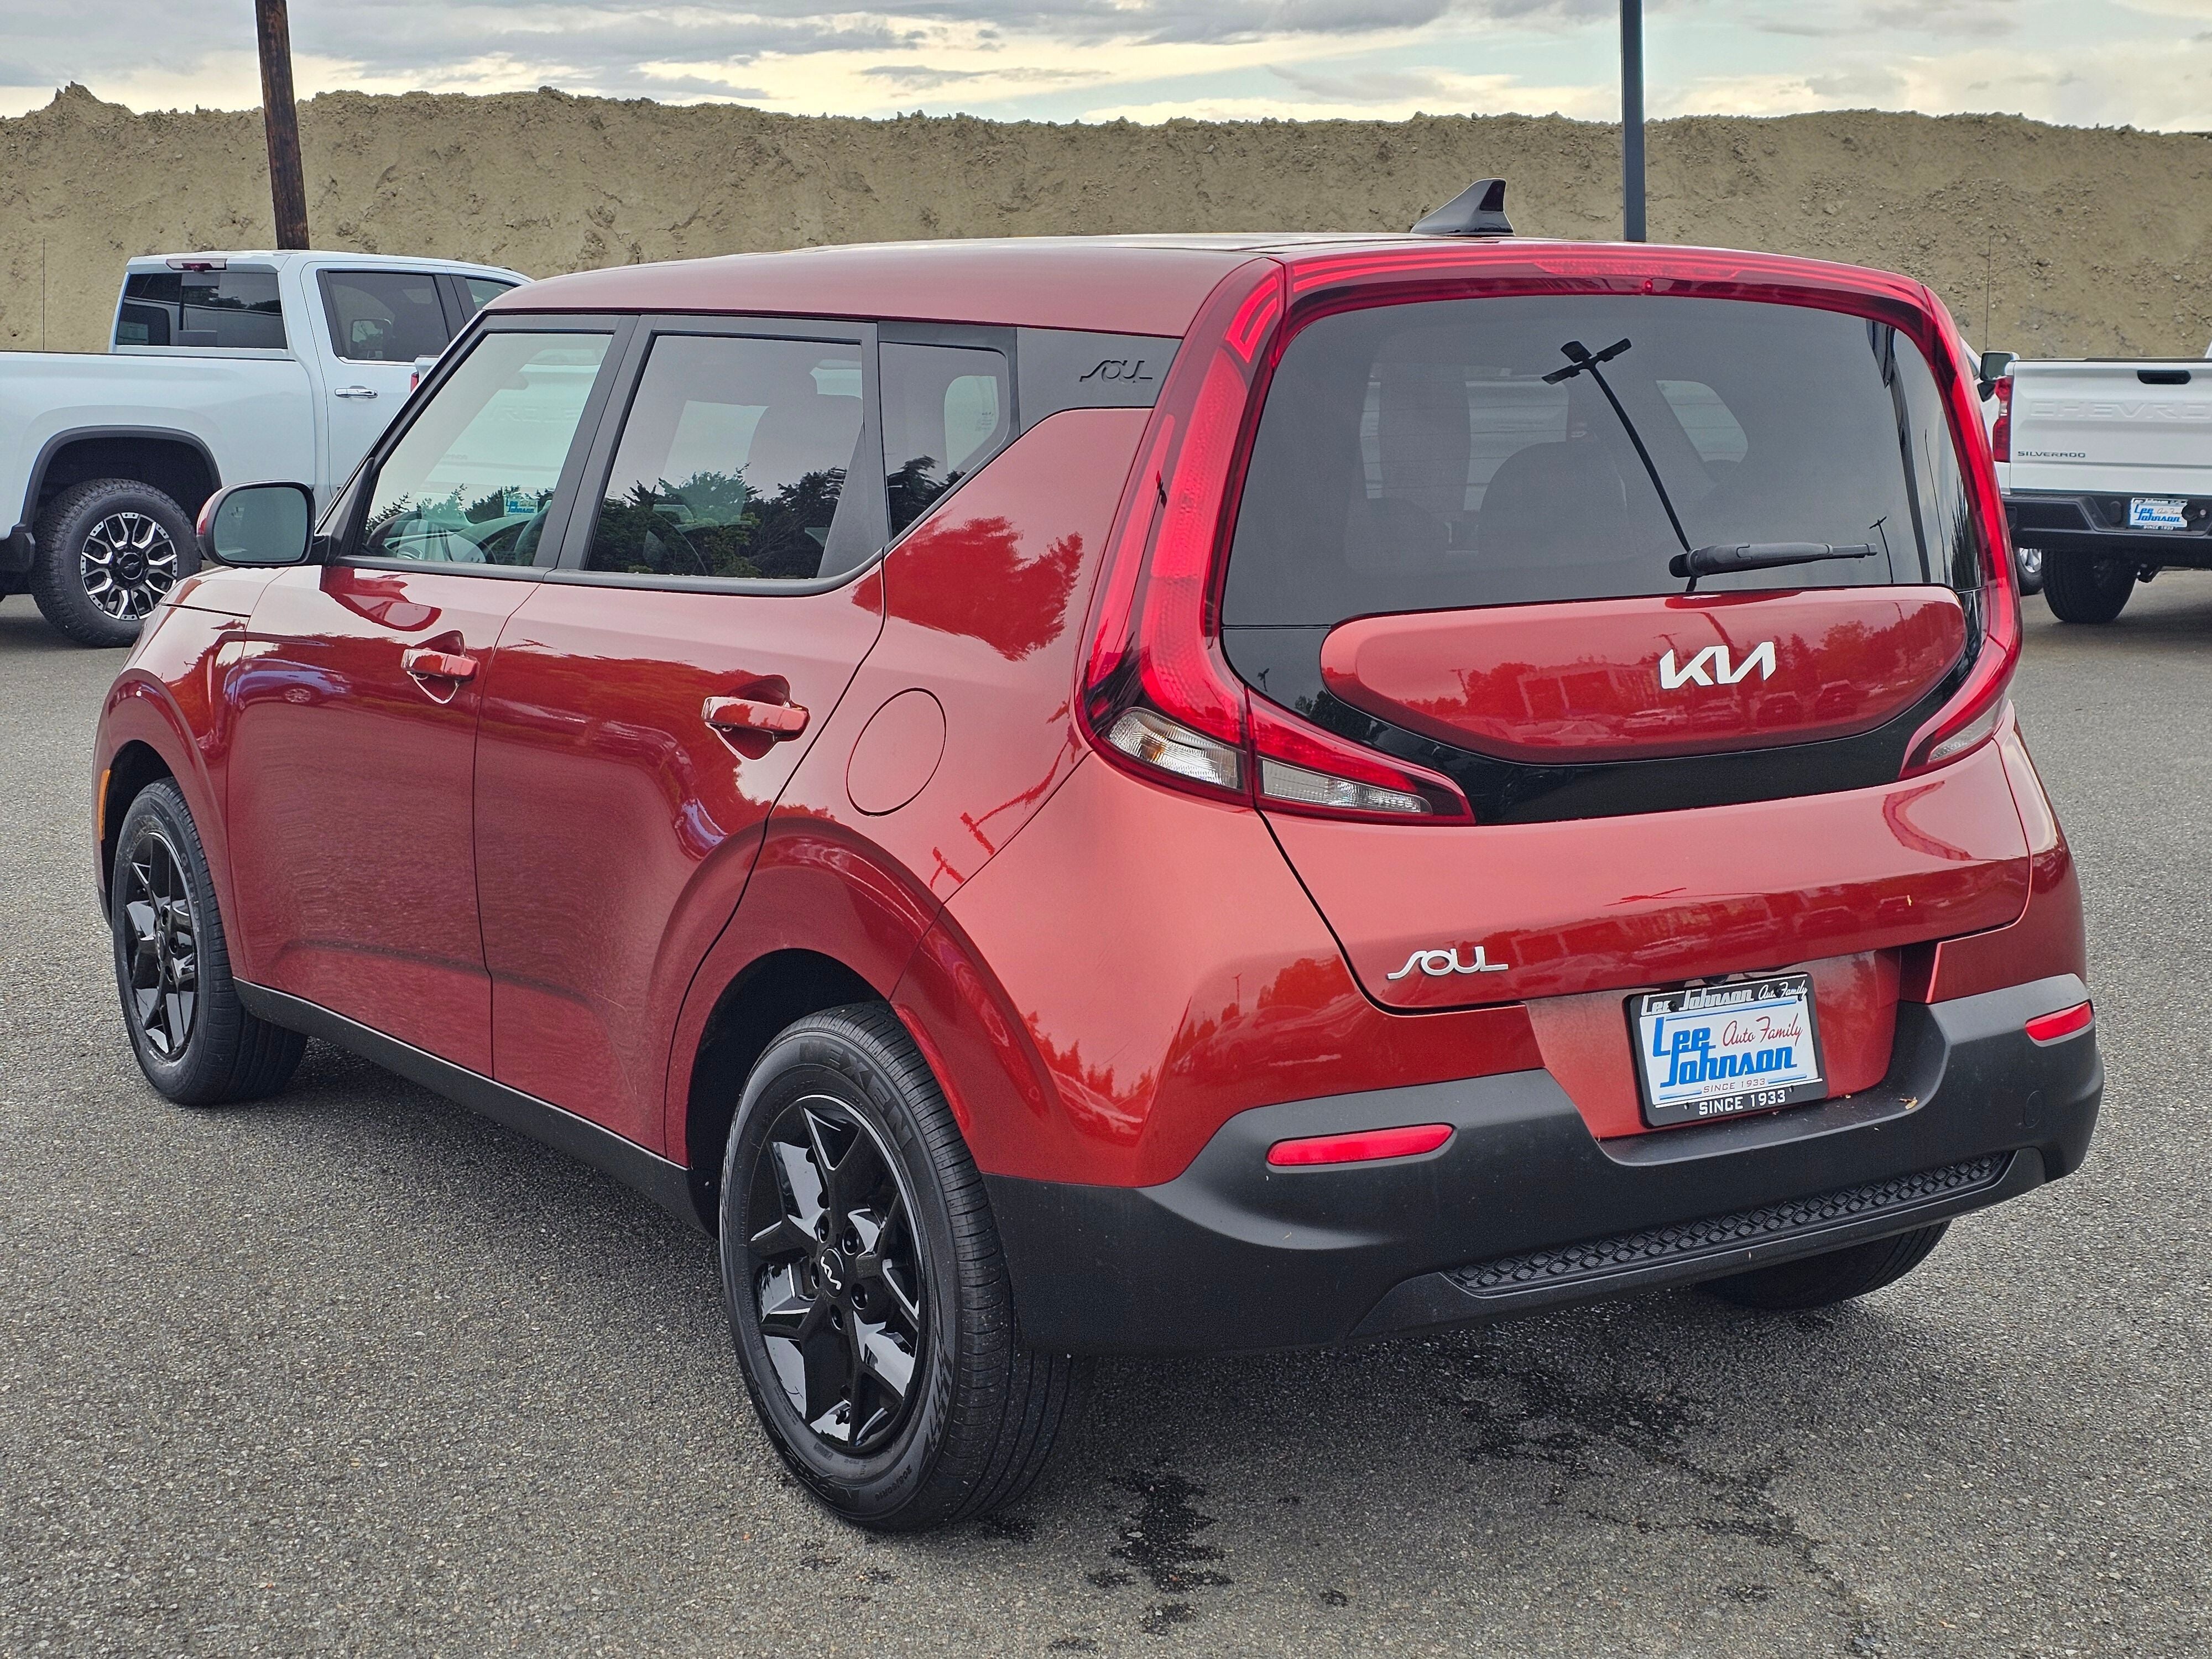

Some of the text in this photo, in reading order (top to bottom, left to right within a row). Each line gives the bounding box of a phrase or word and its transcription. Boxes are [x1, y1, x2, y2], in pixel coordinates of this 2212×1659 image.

[1079, 359, 1153, 384] SOUL
[2135, 504, 2155, 514] Lee
[2136, 509, 2181, 522] Johnson
[1387, 946, 1509, 979] SOUL
[1678, 987, 1755, 1011] Johnson
[1652, 1013, 1803, 1057] Lee Auto Family
[1660, 1045, 1798, 1088] Johnson
[799, 1039, 913, 1150] NEXEN
[1703, 1078, 1766, 1093] SINCE 1933
[1698, 1089, 1786, 1115] SINCE 1933
